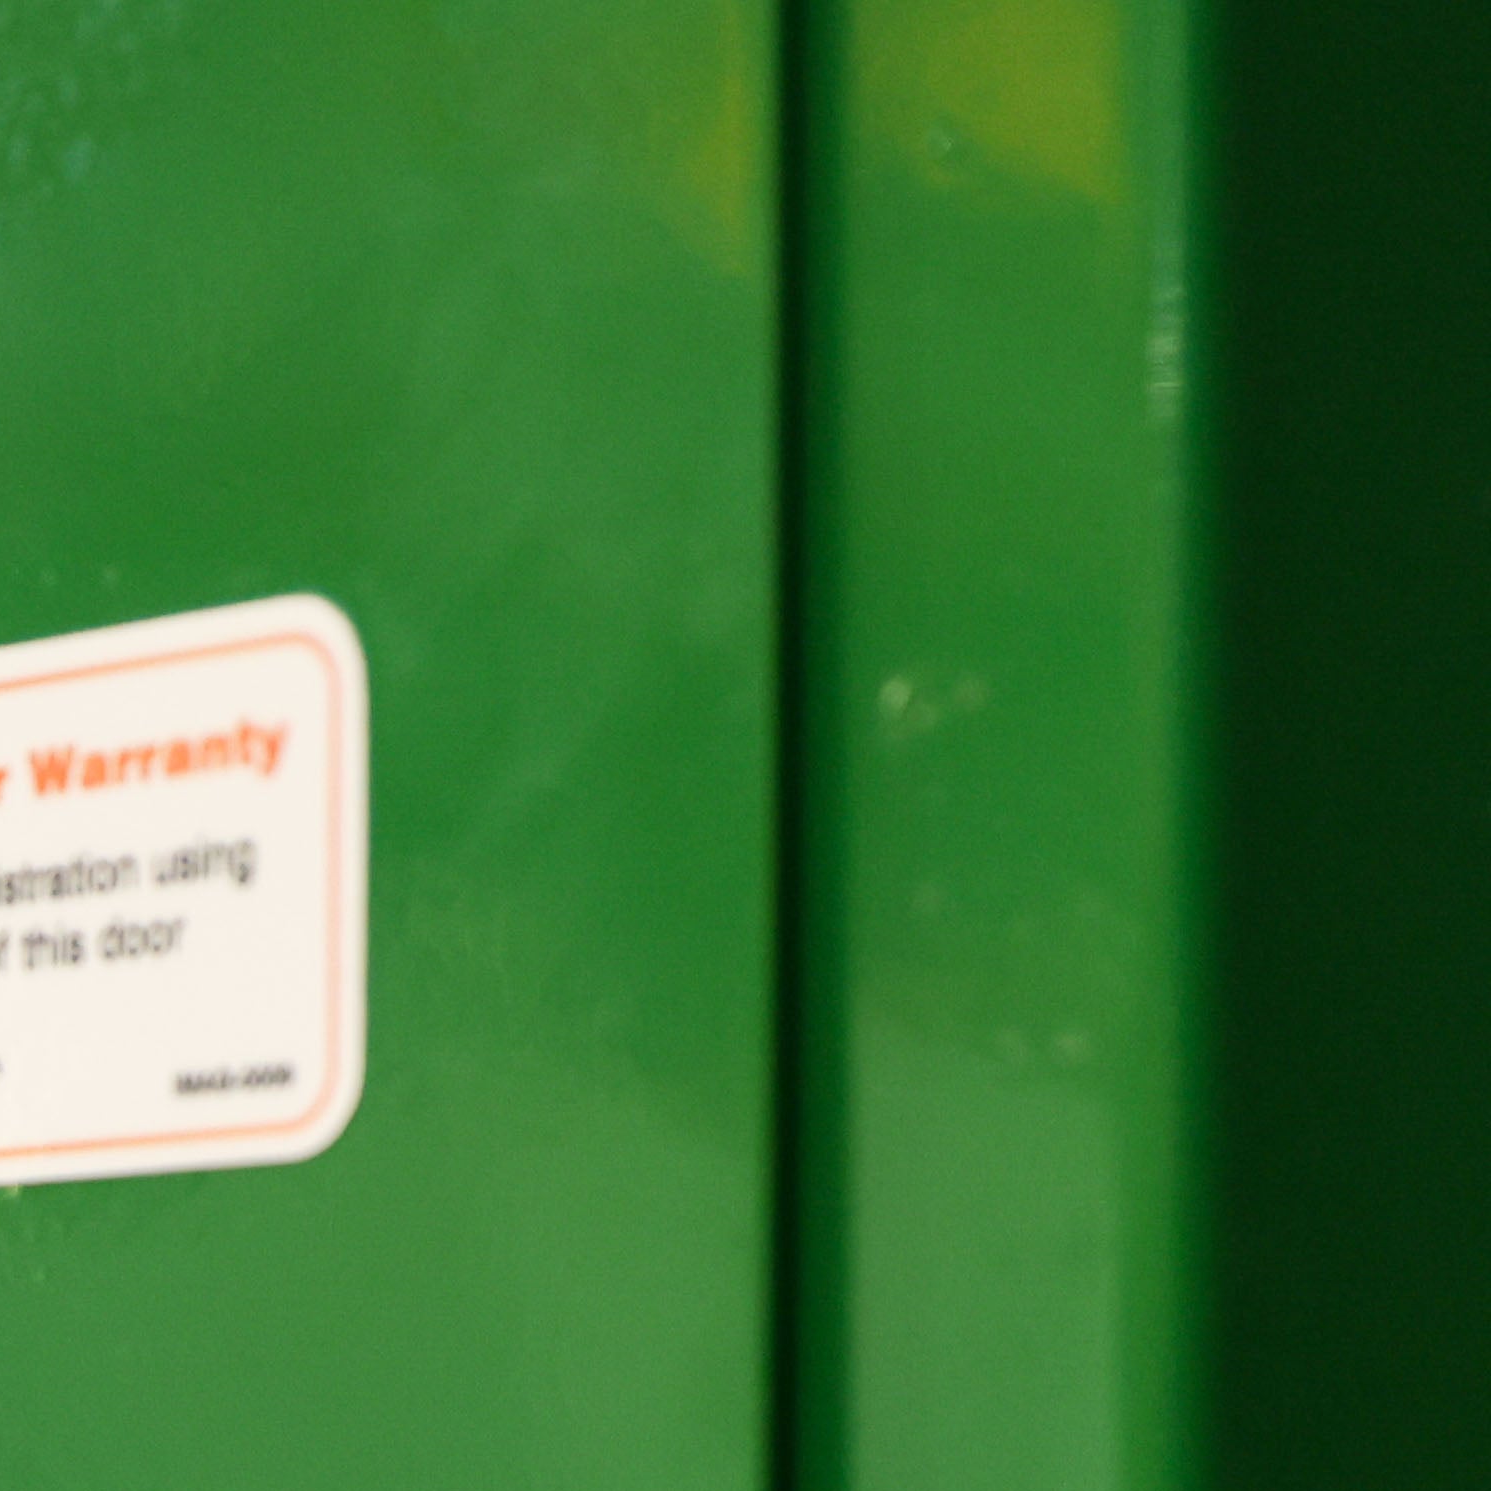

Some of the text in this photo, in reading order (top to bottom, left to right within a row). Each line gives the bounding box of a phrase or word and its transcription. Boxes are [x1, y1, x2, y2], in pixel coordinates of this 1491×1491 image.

[30, 717, 289, 797] Warranty
[153, 835, 256, 891] using
[21, 926, 85, 972] this
[101, 915, 186, 963] door
